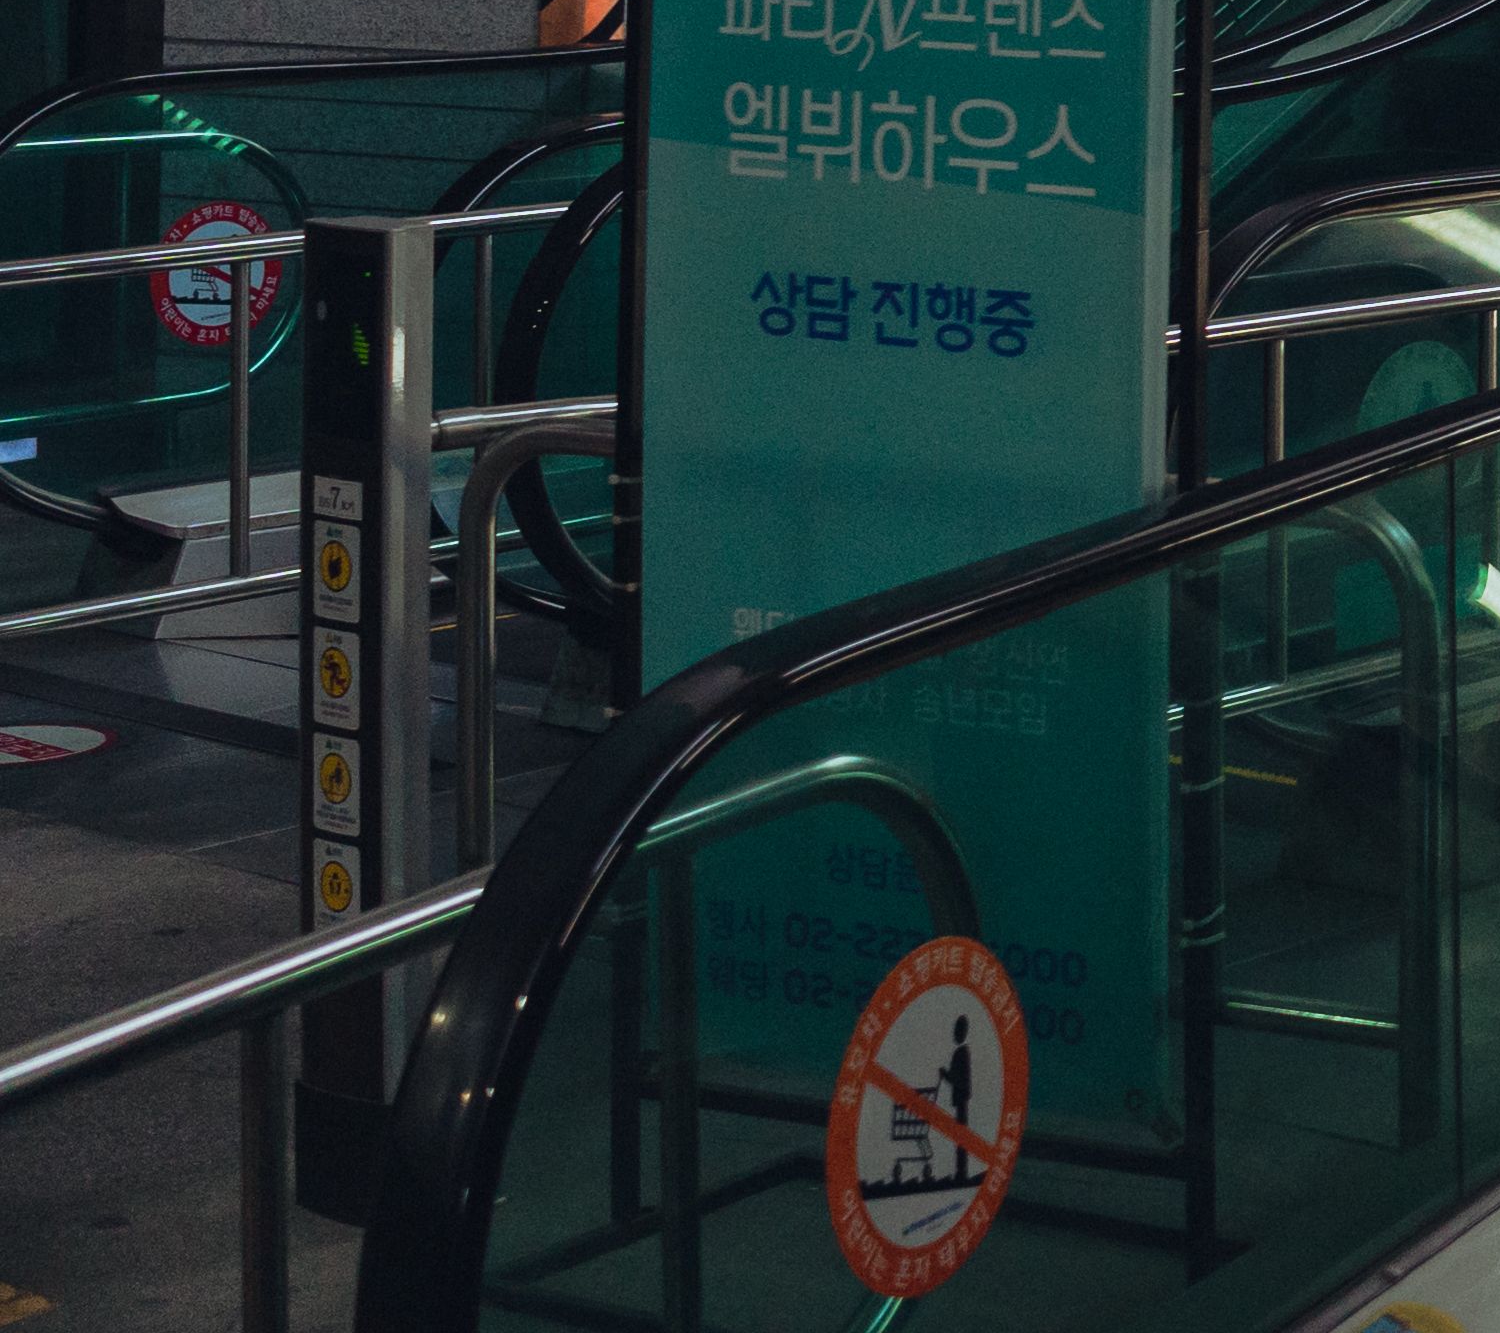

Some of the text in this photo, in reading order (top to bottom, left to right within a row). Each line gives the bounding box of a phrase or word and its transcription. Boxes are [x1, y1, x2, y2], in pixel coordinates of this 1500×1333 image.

[722, 80, 1098, 199] 엘뷔하우스
[187, 203, 235, 225] 쇼핑카트
[156, 296, 194, 337] 어린이는
[195, 327, 220, 341] 혼자
[750, 271, 1035, 359] 상담 진행중
